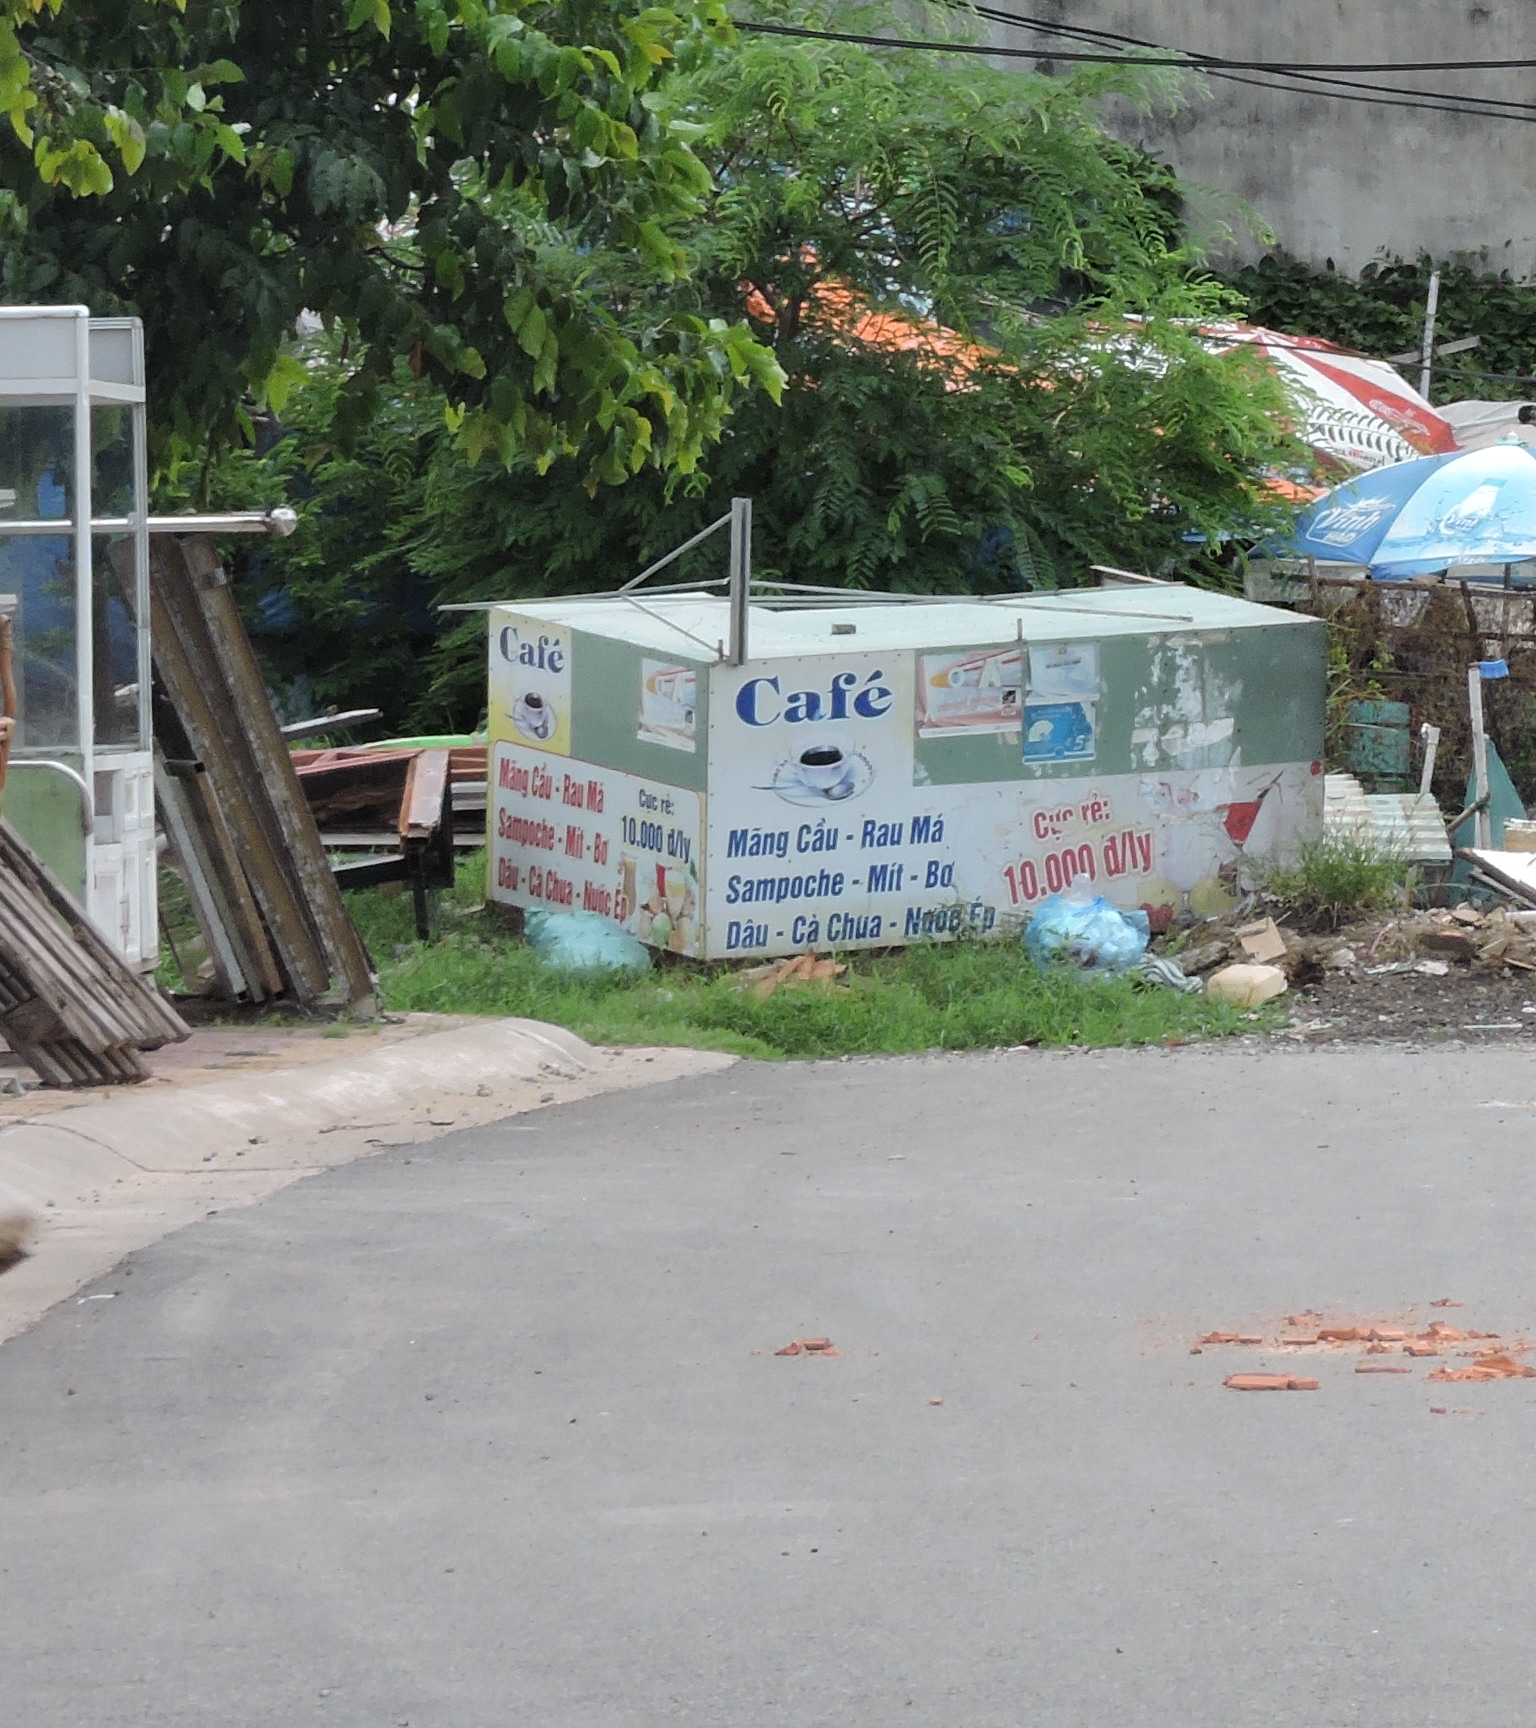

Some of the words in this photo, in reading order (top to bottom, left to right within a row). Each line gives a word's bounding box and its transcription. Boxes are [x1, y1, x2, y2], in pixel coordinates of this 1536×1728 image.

[500, 625, 566, 674] Café
[735, 670, 892, 727] Café
[563, 774, 584, 809] Rau
[586, 780, 605, 813] Má
[498, 807, 555, 851] Sampoche
[622, 815, 663, 853] 10.000
[726, 827, 789, 859] Mãng
[860, 819, 903, 849] Rau
[910, 813, 944, 845] Má
[546, 869, 573, 905] Chua
[726, 869, 845, 904] Sampoche
[867, 862, 904, 893] Mít
[925, 860, 955, 889] Bơ
[1004, 843, 1096, 905] 10.000
[1103, 830, 1151, 877] đ/ly
[726, 919, 769, 950] Dâu
[827, 912, 882, 942] Chua
